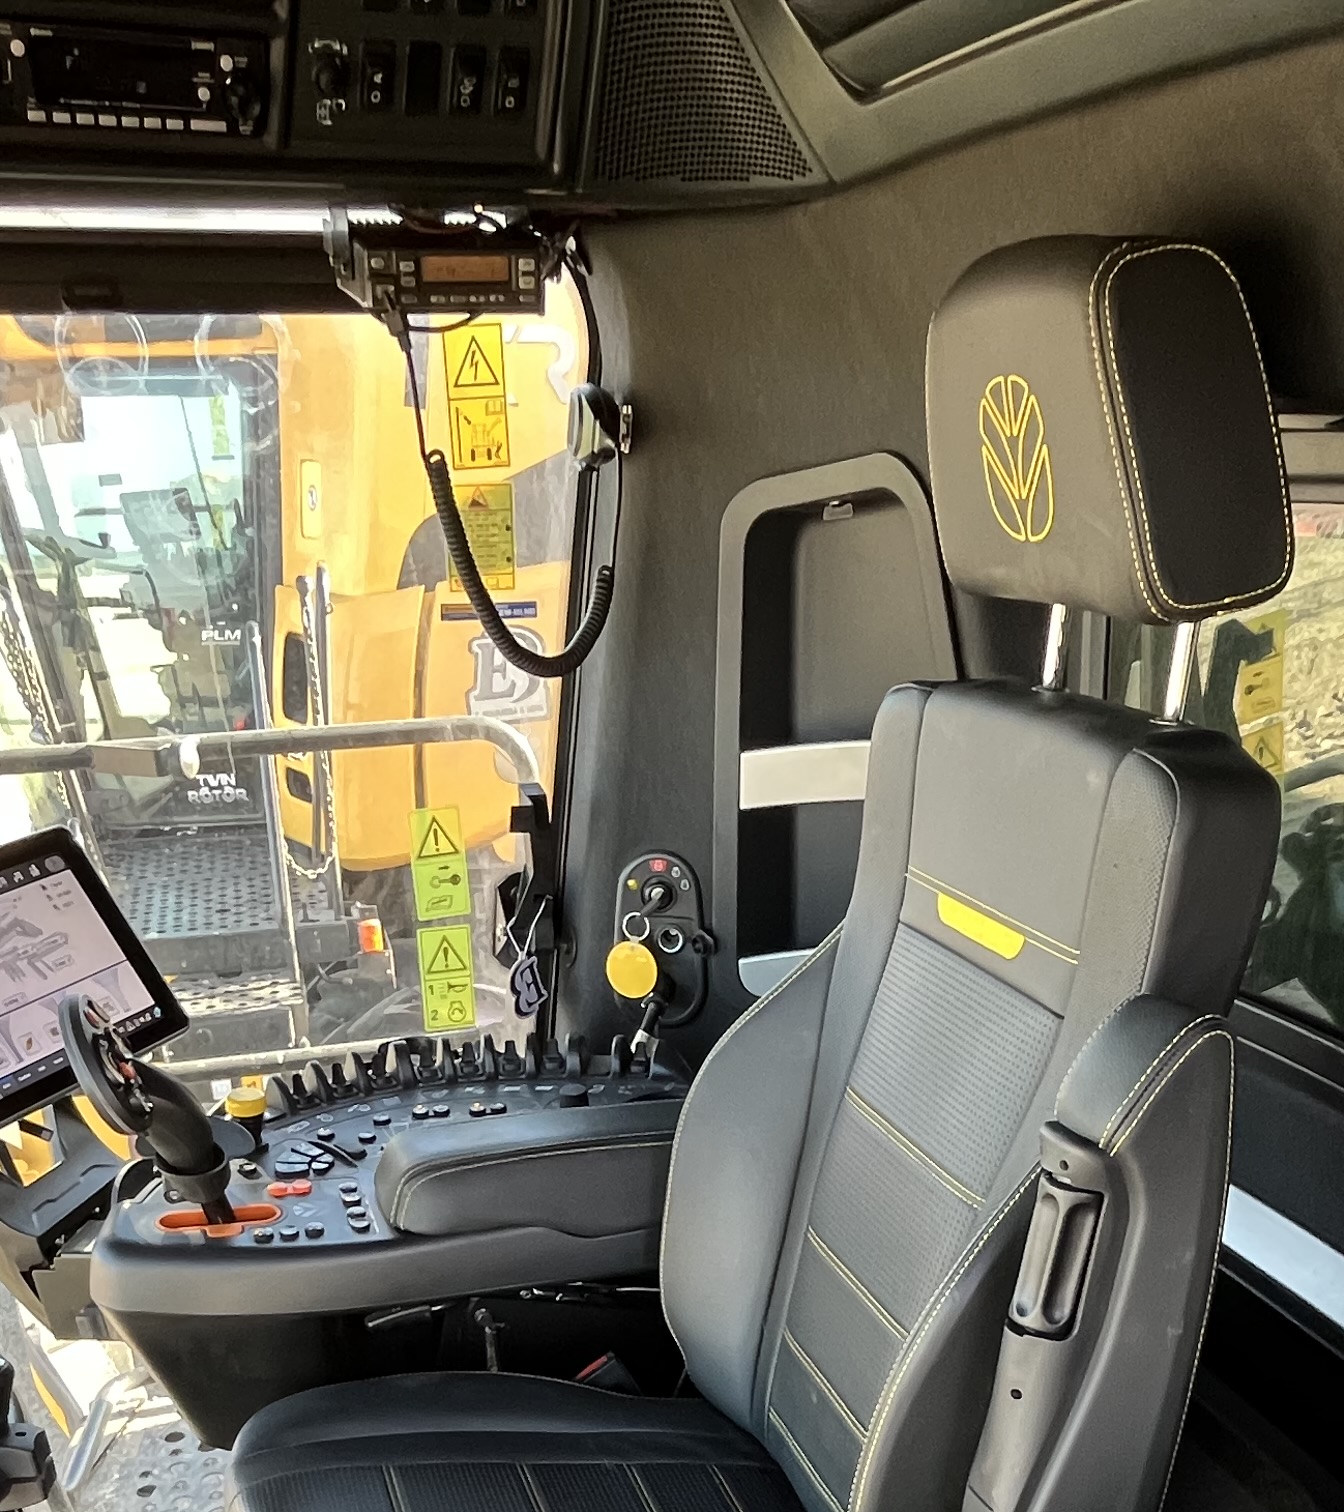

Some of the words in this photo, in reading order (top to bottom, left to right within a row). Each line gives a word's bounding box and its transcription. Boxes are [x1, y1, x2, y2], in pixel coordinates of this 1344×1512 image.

[201, 629, 242, 641] PLM
[196, 773, 236, 787] TWIN
[187, 785, 250, 804] ROTOR
[428, 984, 435, 996] 1
[430, 1009, 439, 1021] 2
